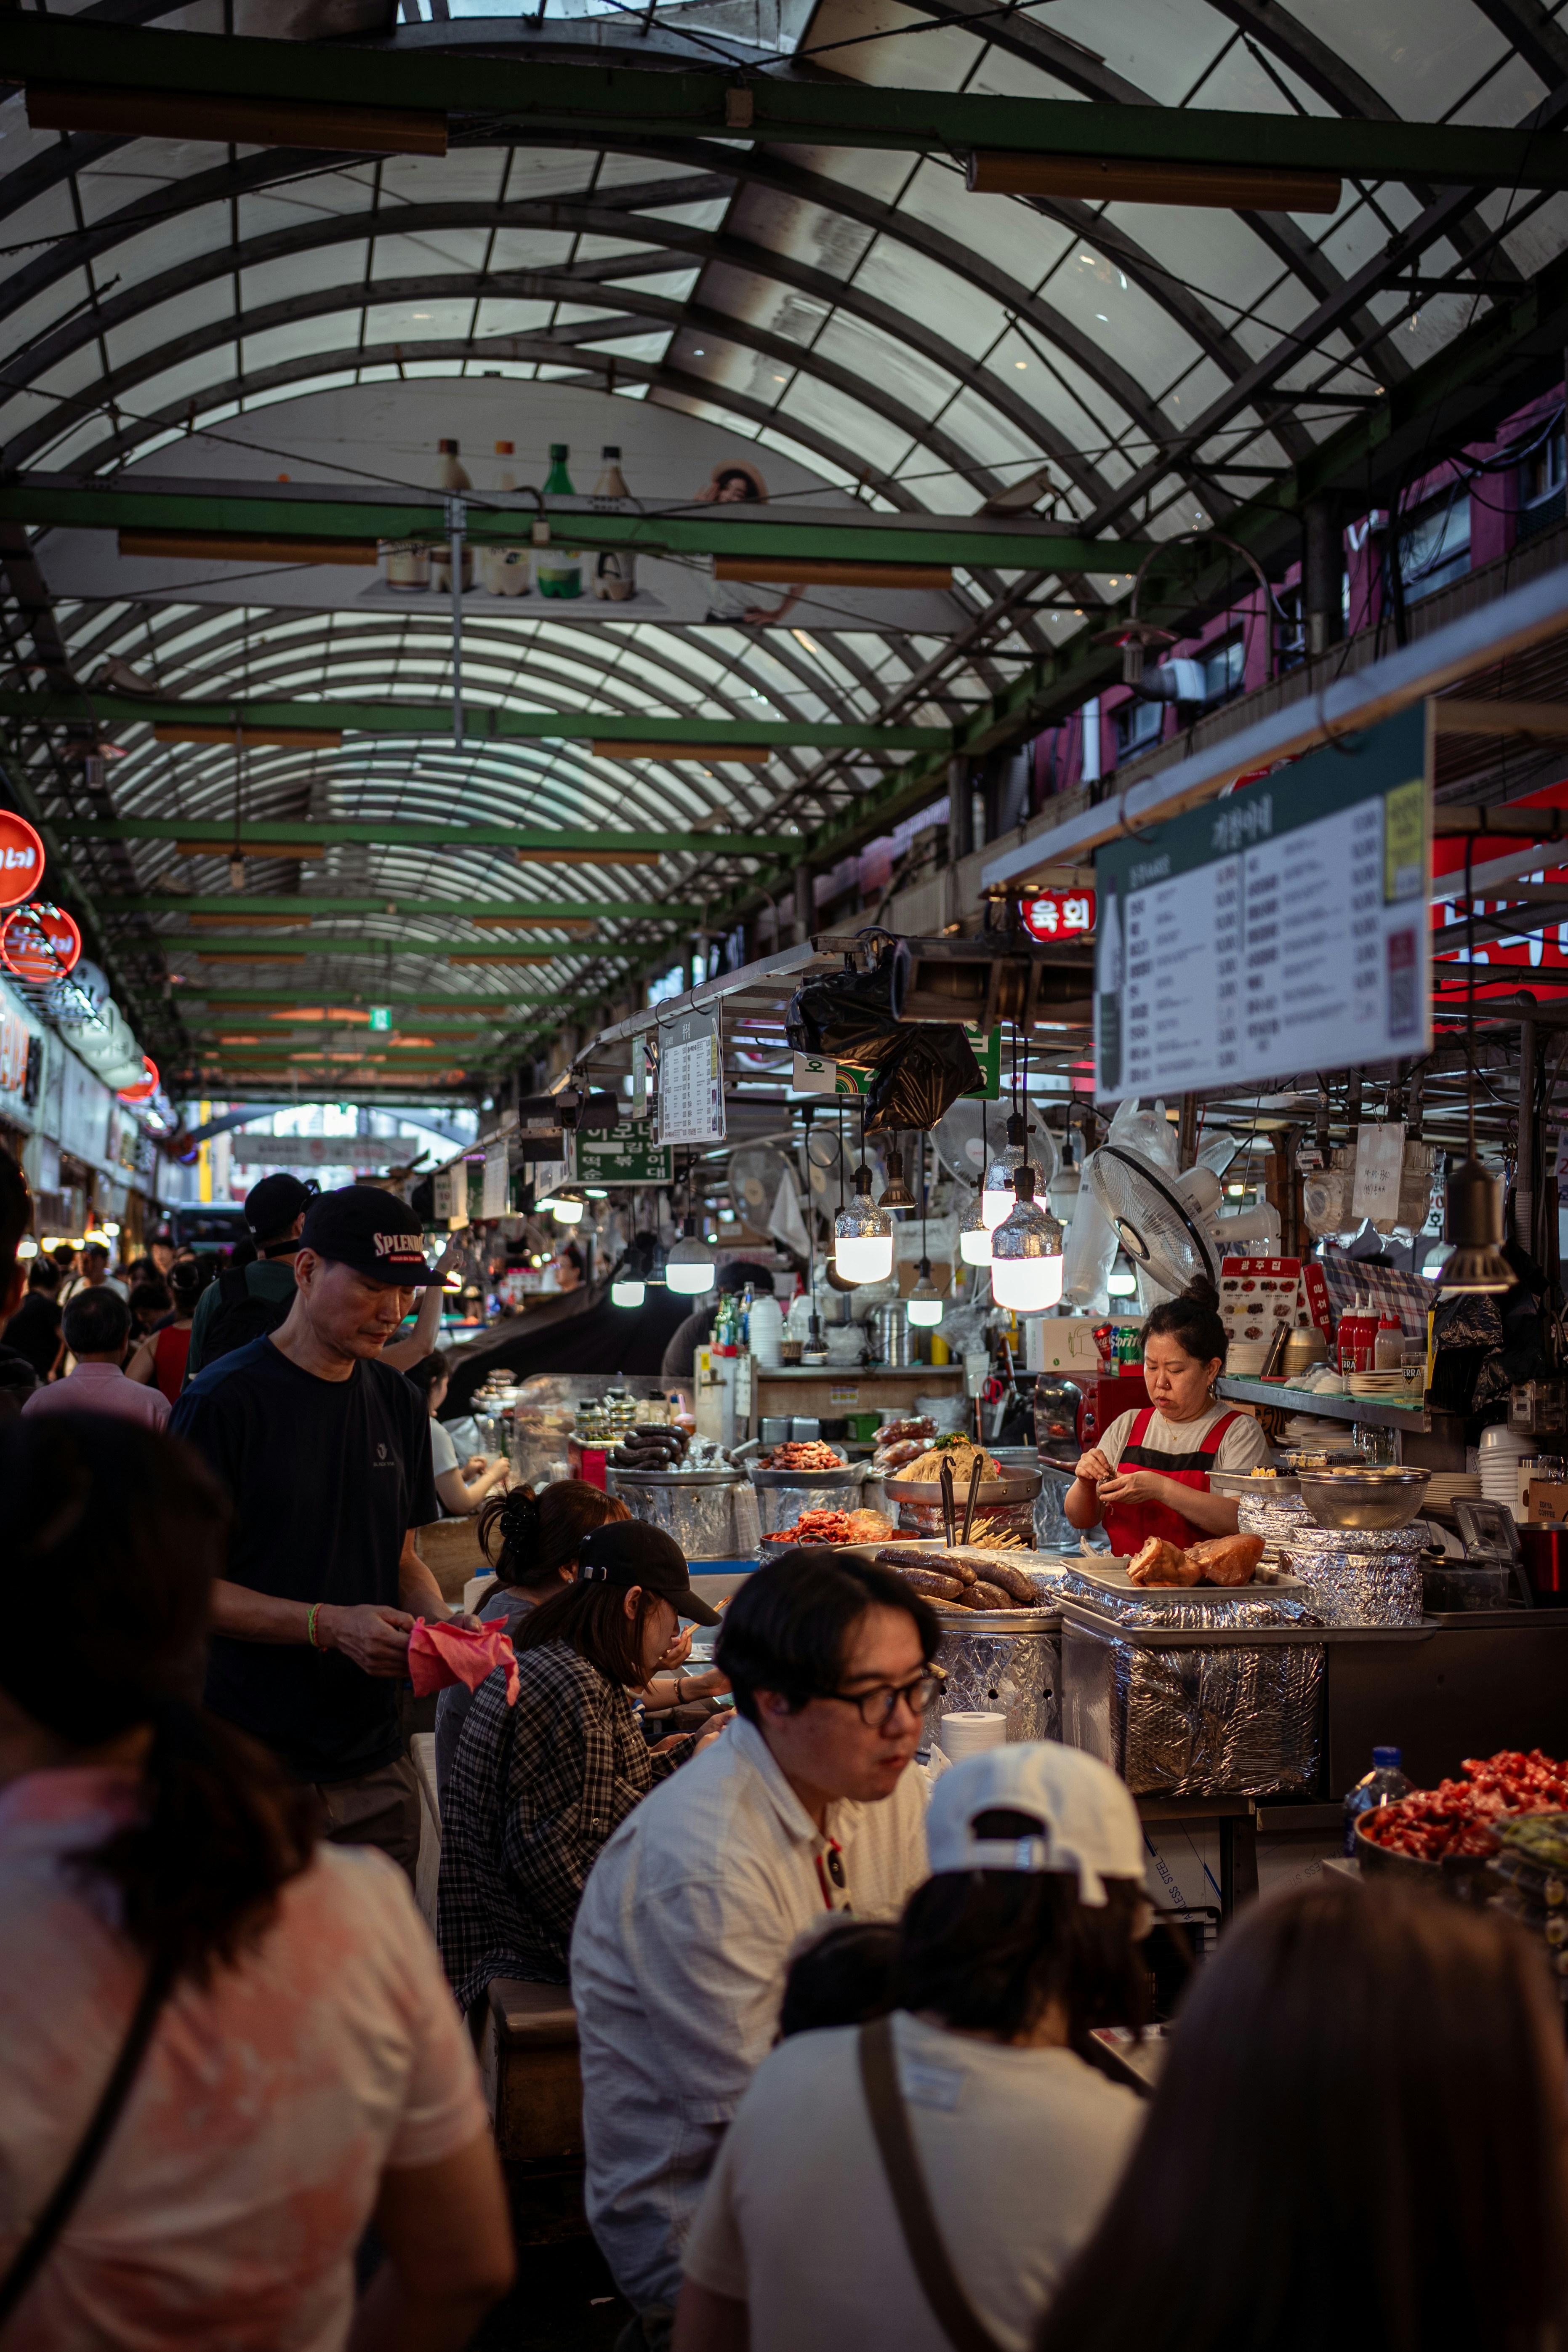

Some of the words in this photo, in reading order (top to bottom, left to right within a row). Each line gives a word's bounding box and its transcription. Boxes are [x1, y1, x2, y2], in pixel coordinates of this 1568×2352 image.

[1030, 898, 1089, 934] 육회
[582, 1155, 665, 1167] 떡볶이
[1428, 1211, 1442, 1227] 호
[1241, 1260, 1281, 1271] 광주집
[1313, 1283, 1330, 1325] 광주집
[1539, 1501, 1553, 1510] EDIYA
[1538, 1508, 1556, 1518] COFFEE
[1155, 1856, 1173, 1885] STEEL
